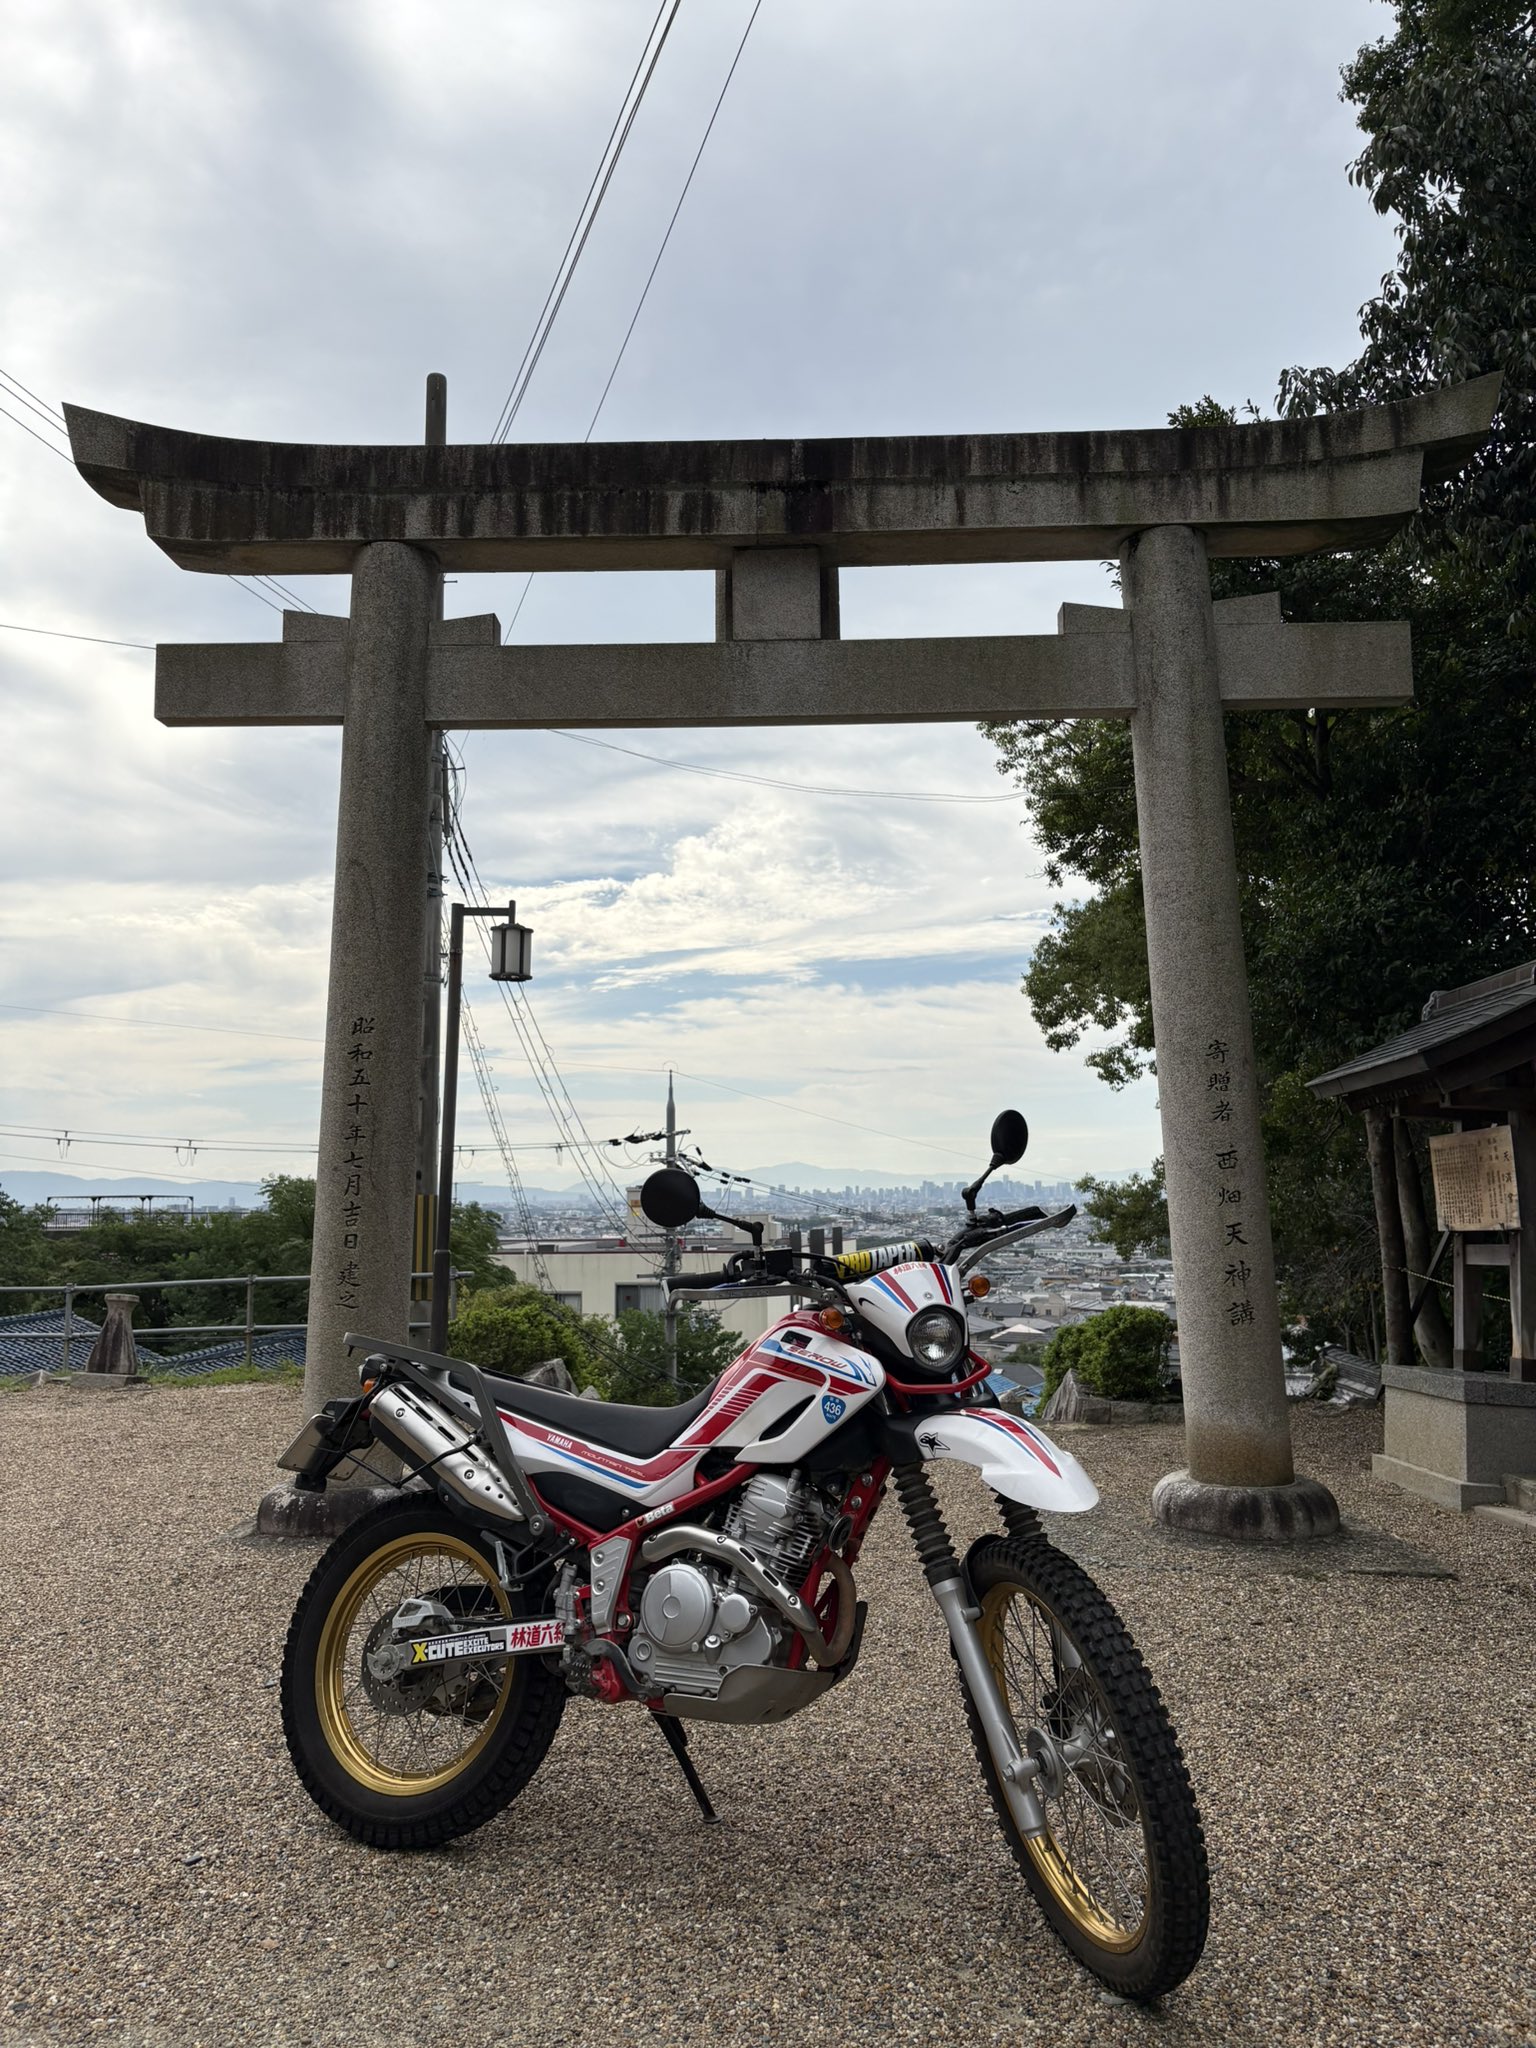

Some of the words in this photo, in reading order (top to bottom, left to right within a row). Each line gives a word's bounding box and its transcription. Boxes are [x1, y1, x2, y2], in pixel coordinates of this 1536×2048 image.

[787, 1345, 848, 1370] SEROW
[824, 1401, 842, 1416] 436
[546, 1433, 574, 1449] YAMAHA
[645, 1503, 674, 1521] Beta
[463, 1636, 489, 1647] EXCITE
[463, 1641, 505, 1655] EXECUTORS
